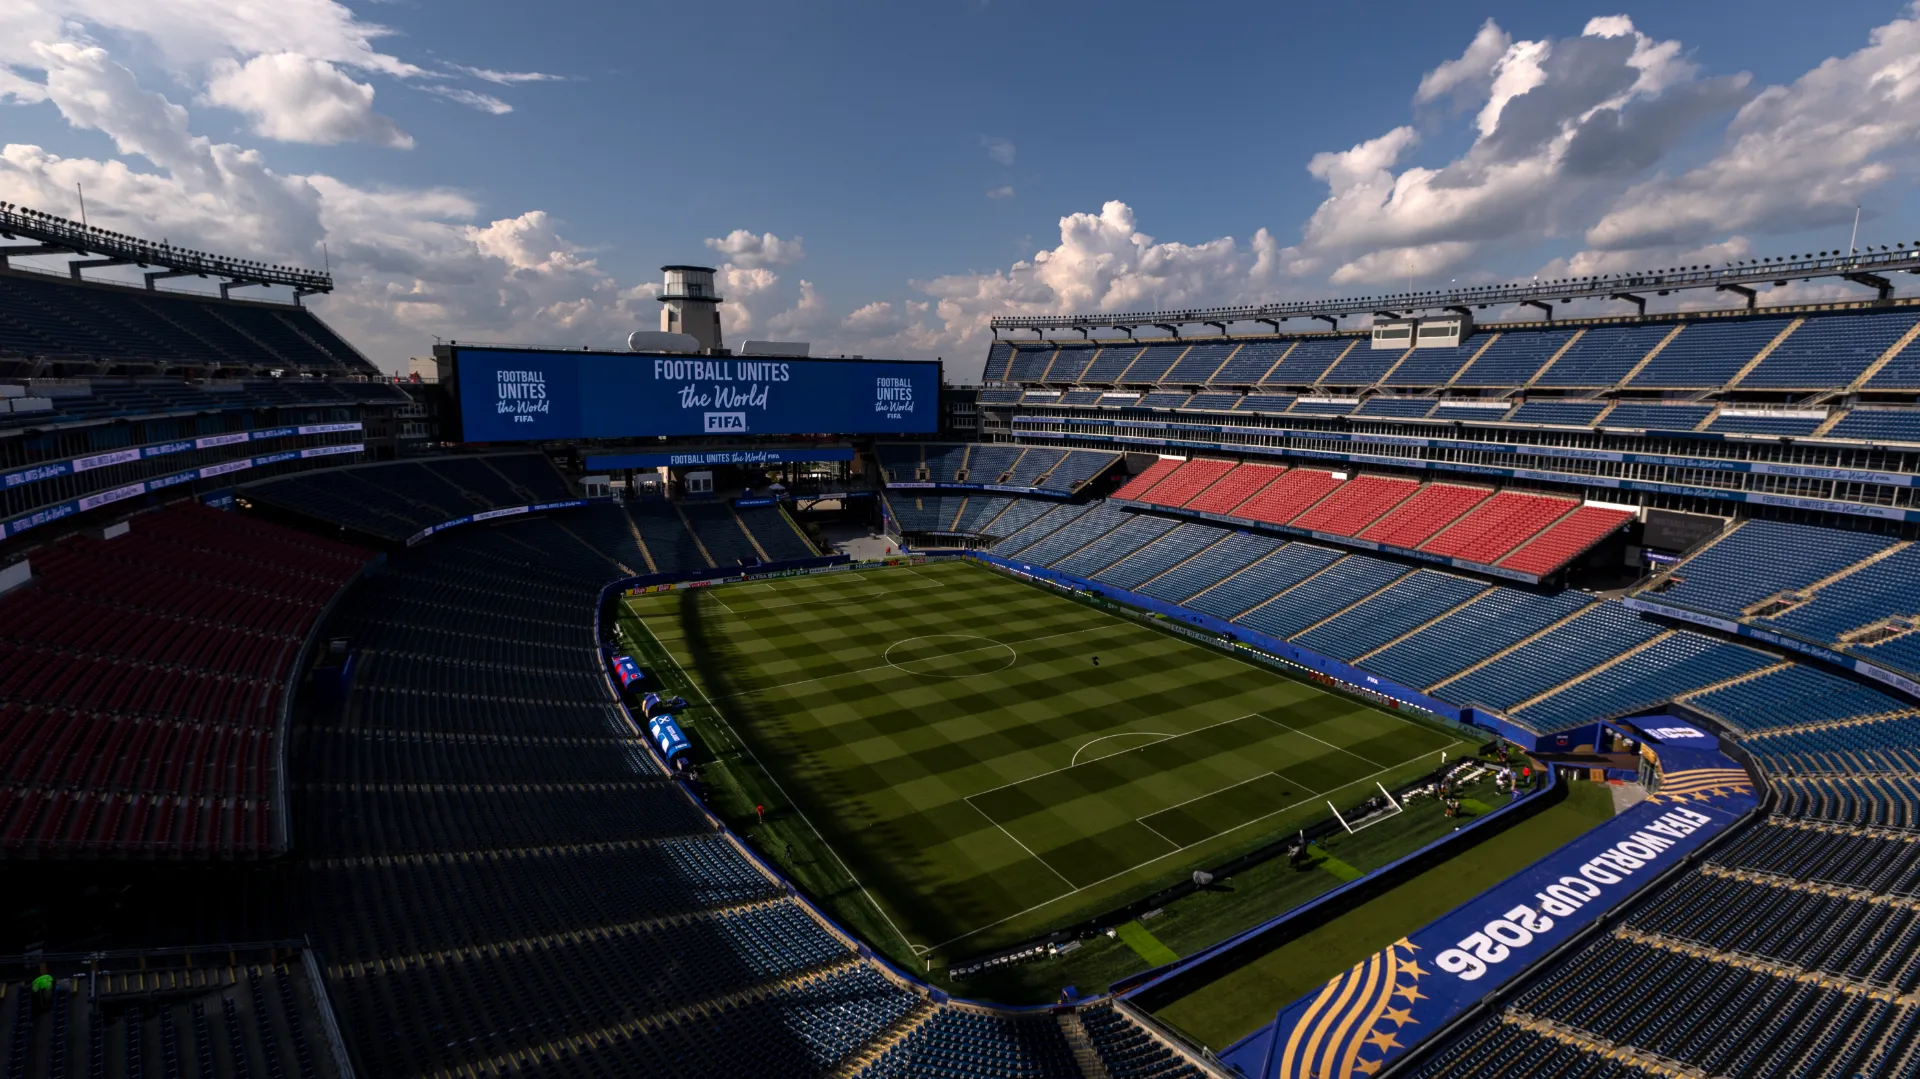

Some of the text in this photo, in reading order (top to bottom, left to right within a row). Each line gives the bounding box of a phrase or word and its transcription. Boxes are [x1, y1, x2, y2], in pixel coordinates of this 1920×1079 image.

[497, 370, 545, 383] FOOTBALL
[655, 360, 790, 382] FOOTBALL UNITES
[877, 377, 912, 387] FOOTBALL
[498, 383, 546, 399] UNITES
[677, 383, 770, 410] the World
[877, 388, 912, 400] UNITES
[496, 400, 550, 414] the World
[874, 401, 914, 413] the World
[514, 415, 534, 423] FIFA
[708, 416, 743, 428] FIFA
[671, 455, 705, 464] FOOTBALL
[706, 454, 729, 463] UNITES
[731, 453, 744, 462] the
[745, 452, 767, 462] World
[1252, 653, 1288, 671] Hisense
[1334, 681, 1391, 706] McDonald's
[1435, 806, 1712, 981] FIFA WORLD CUP 2026
